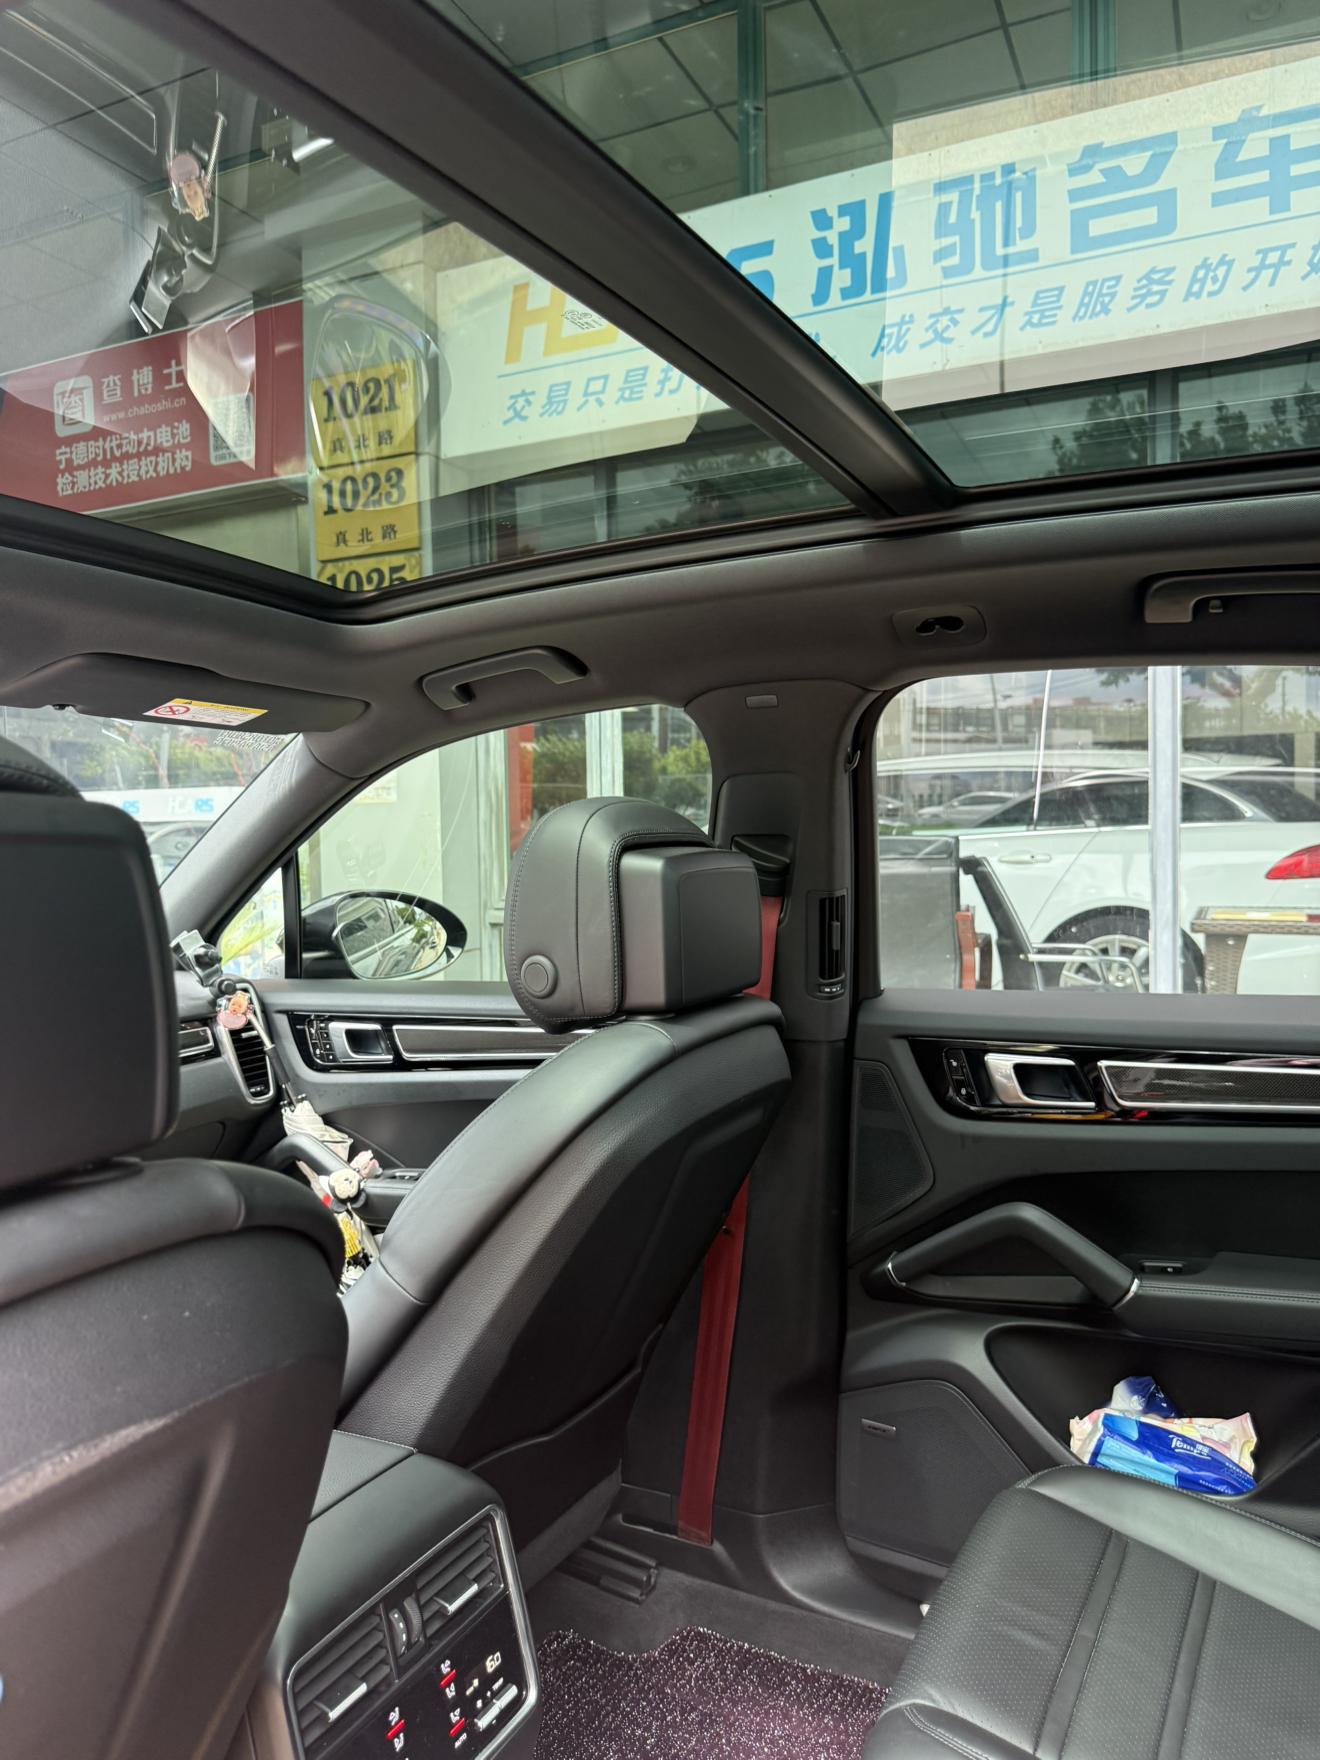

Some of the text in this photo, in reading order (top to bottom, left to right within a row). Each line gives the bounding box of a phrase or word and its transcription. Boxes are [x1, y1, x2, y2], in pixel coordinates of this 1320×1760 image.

[810, 103, 1320, 308] 泓驰名车
[101, 359, 185, 404] 查博士
[322, 375, 401, 423] 1021
[501, 364, 701, 426] 交易只是打
[103, 397, 187, 422] www.chaboshi.cn
[56, 420, 191, 469] 宁德时代动力电池
[332, 430, 394, 454] 真北路
[56, 448, 192, 497] 检测技术授权机构
[322, 467, 406, 516] 1023
[335, 524, 398, 547] 真北路
